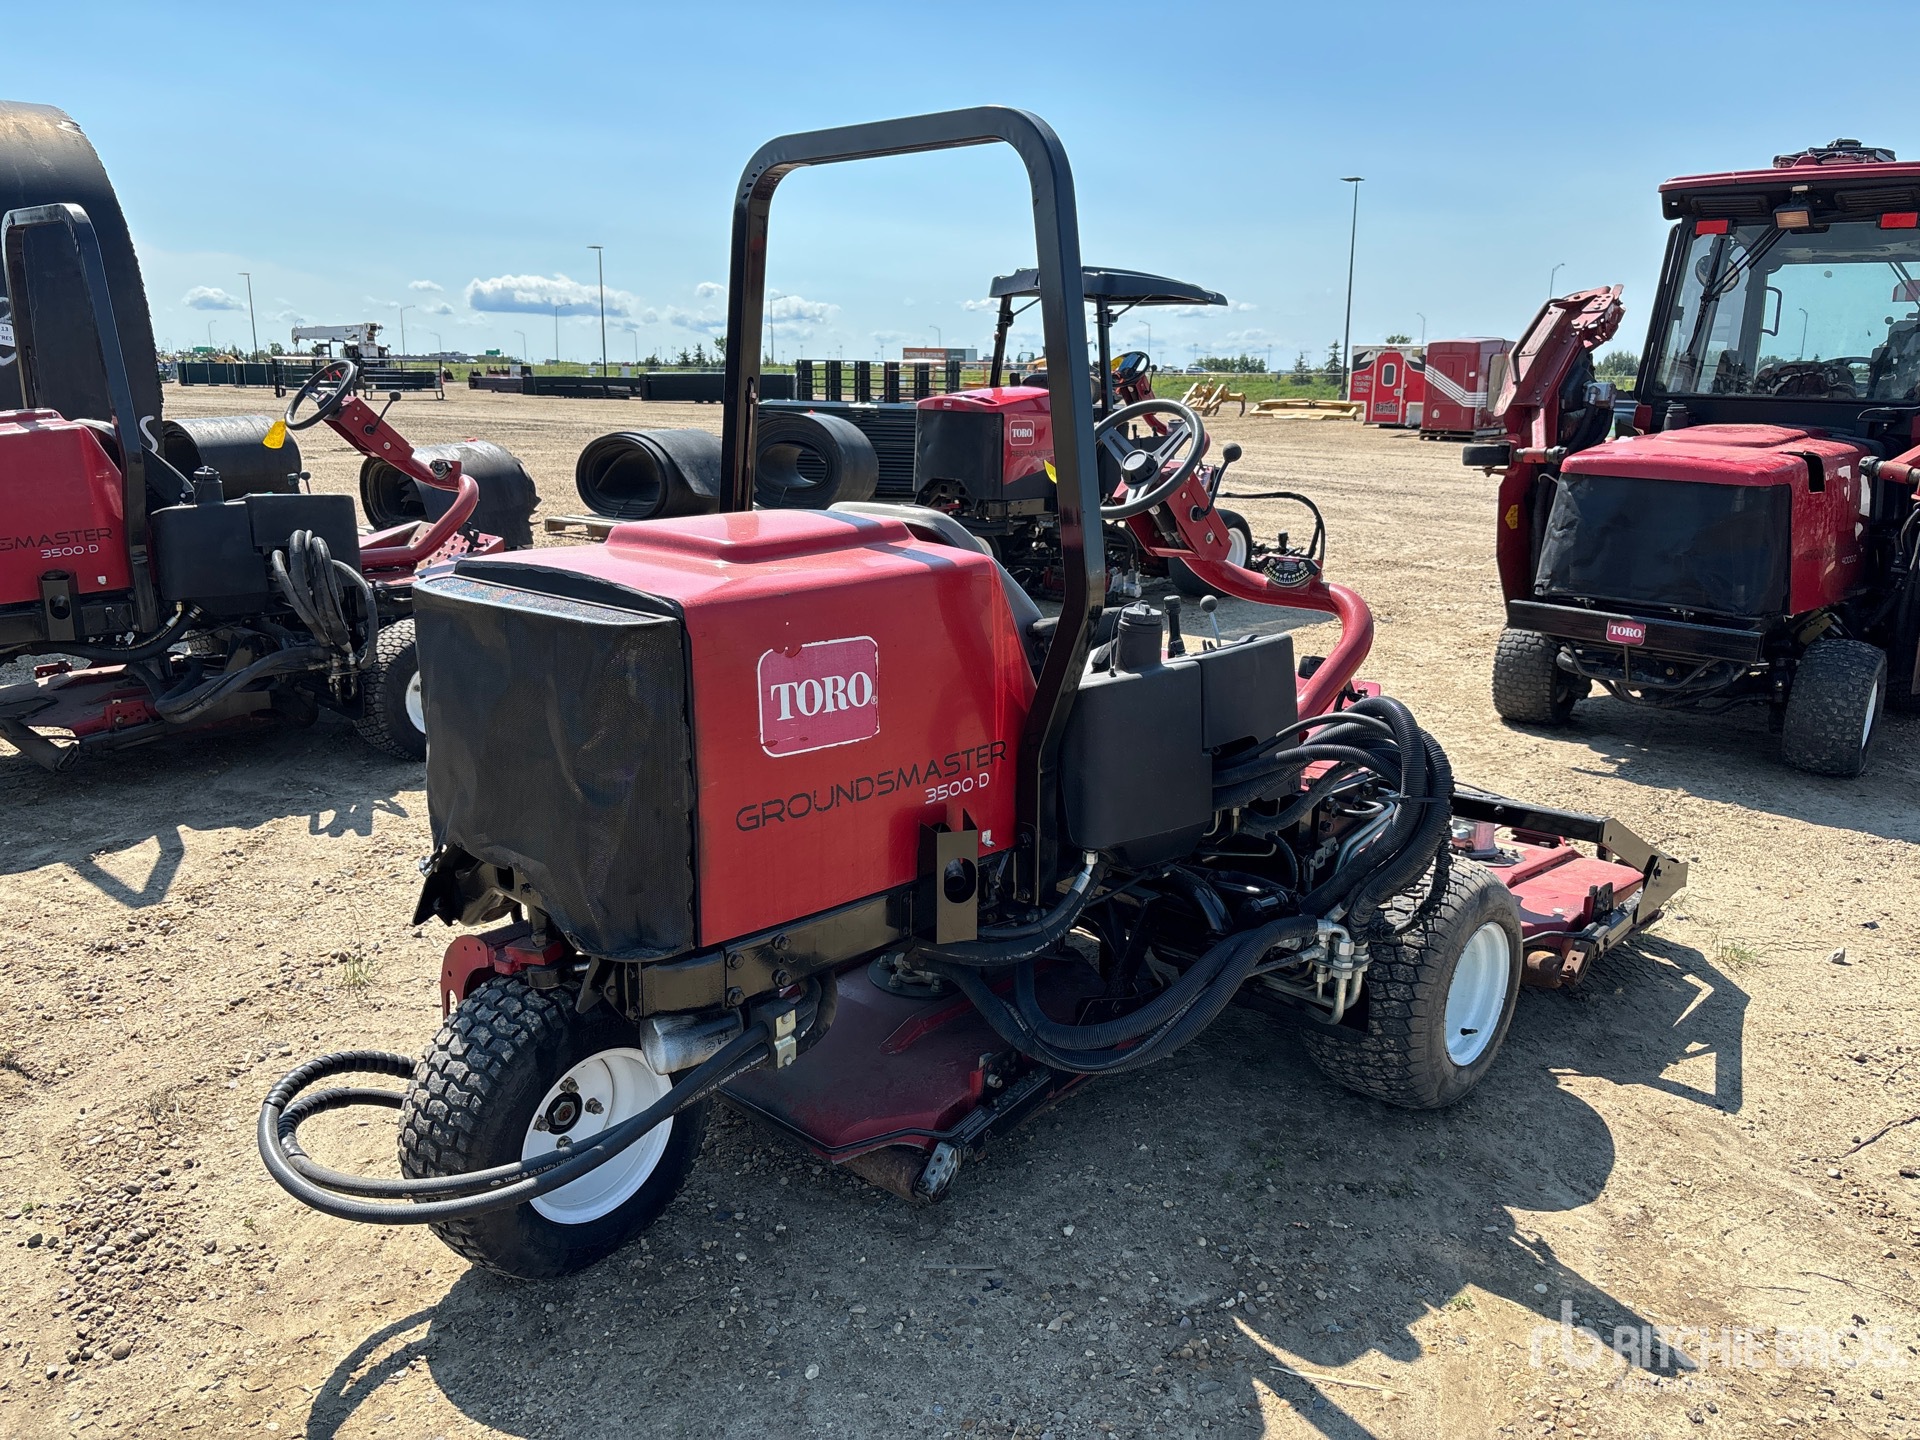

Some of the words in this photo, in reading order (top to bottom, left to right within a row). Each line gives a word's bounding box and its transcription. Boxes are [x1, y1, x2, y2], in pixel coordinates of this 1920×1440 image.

[1011, 428, 1033, 438] TORO
[1610, 625, 1642, 638] TORO
[770, 671, 873, 721] TORO
[735, 740, 1007, 832] GROUNDSMASTER
